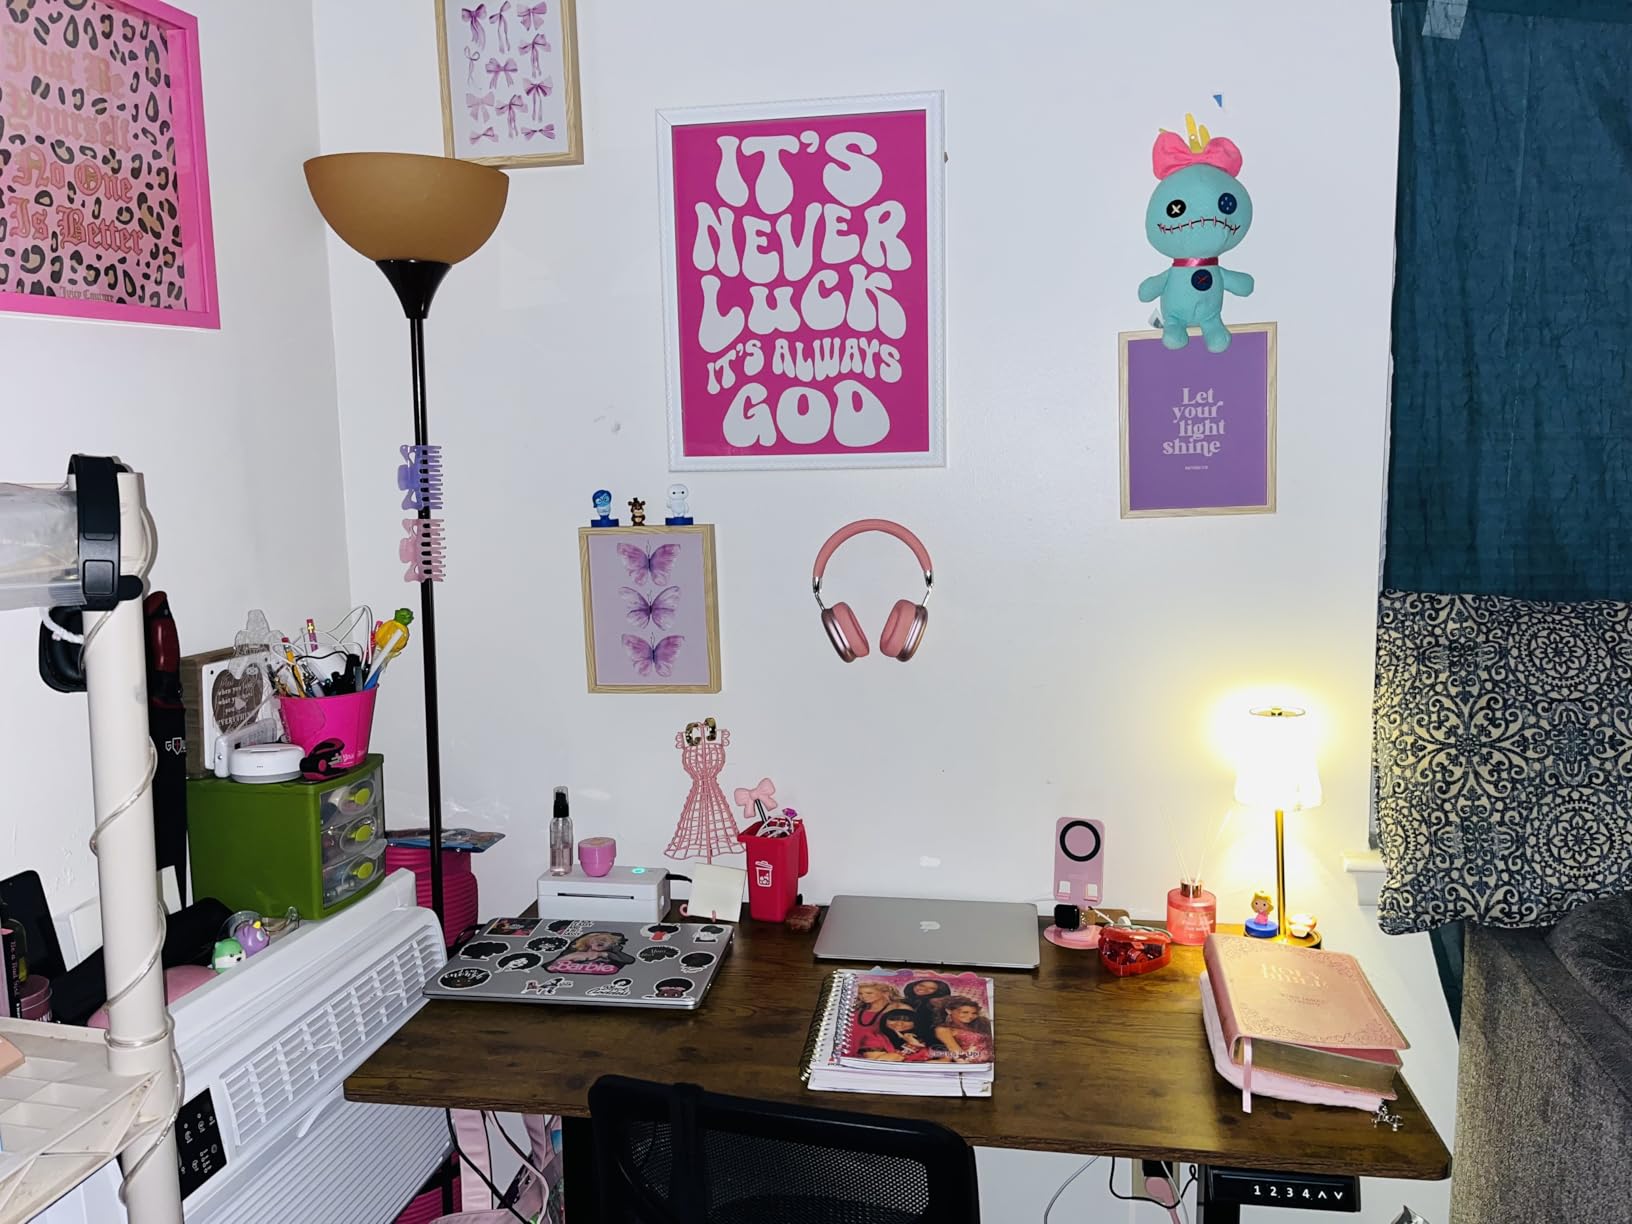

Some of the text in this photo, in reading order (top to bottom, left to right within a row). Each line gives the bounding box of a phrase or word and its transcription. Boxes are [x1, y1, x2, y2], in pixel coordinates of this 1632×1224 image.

[11, 145, 133, 204] No One
[714, 130, 883, 215] IT'S
[8, 195, 144, 257] Is Better
[692, 200, 912, 284] NEVER
[698, 263, 907, 353] LUCK
[707, 336, 902, 395] IT'S ALWAYS
[722, 379, 891, 447] GOD
[1172, 401, 1224, 424] your
[1181, 387, 1215, 405] Let
[1162, 438, 1221, 457] shine
[1178, 419, 1226, 440] light
[548, 959, 615, 973] Barbie
[1253, 1185, 1310, 1199] 1 2 3 4
